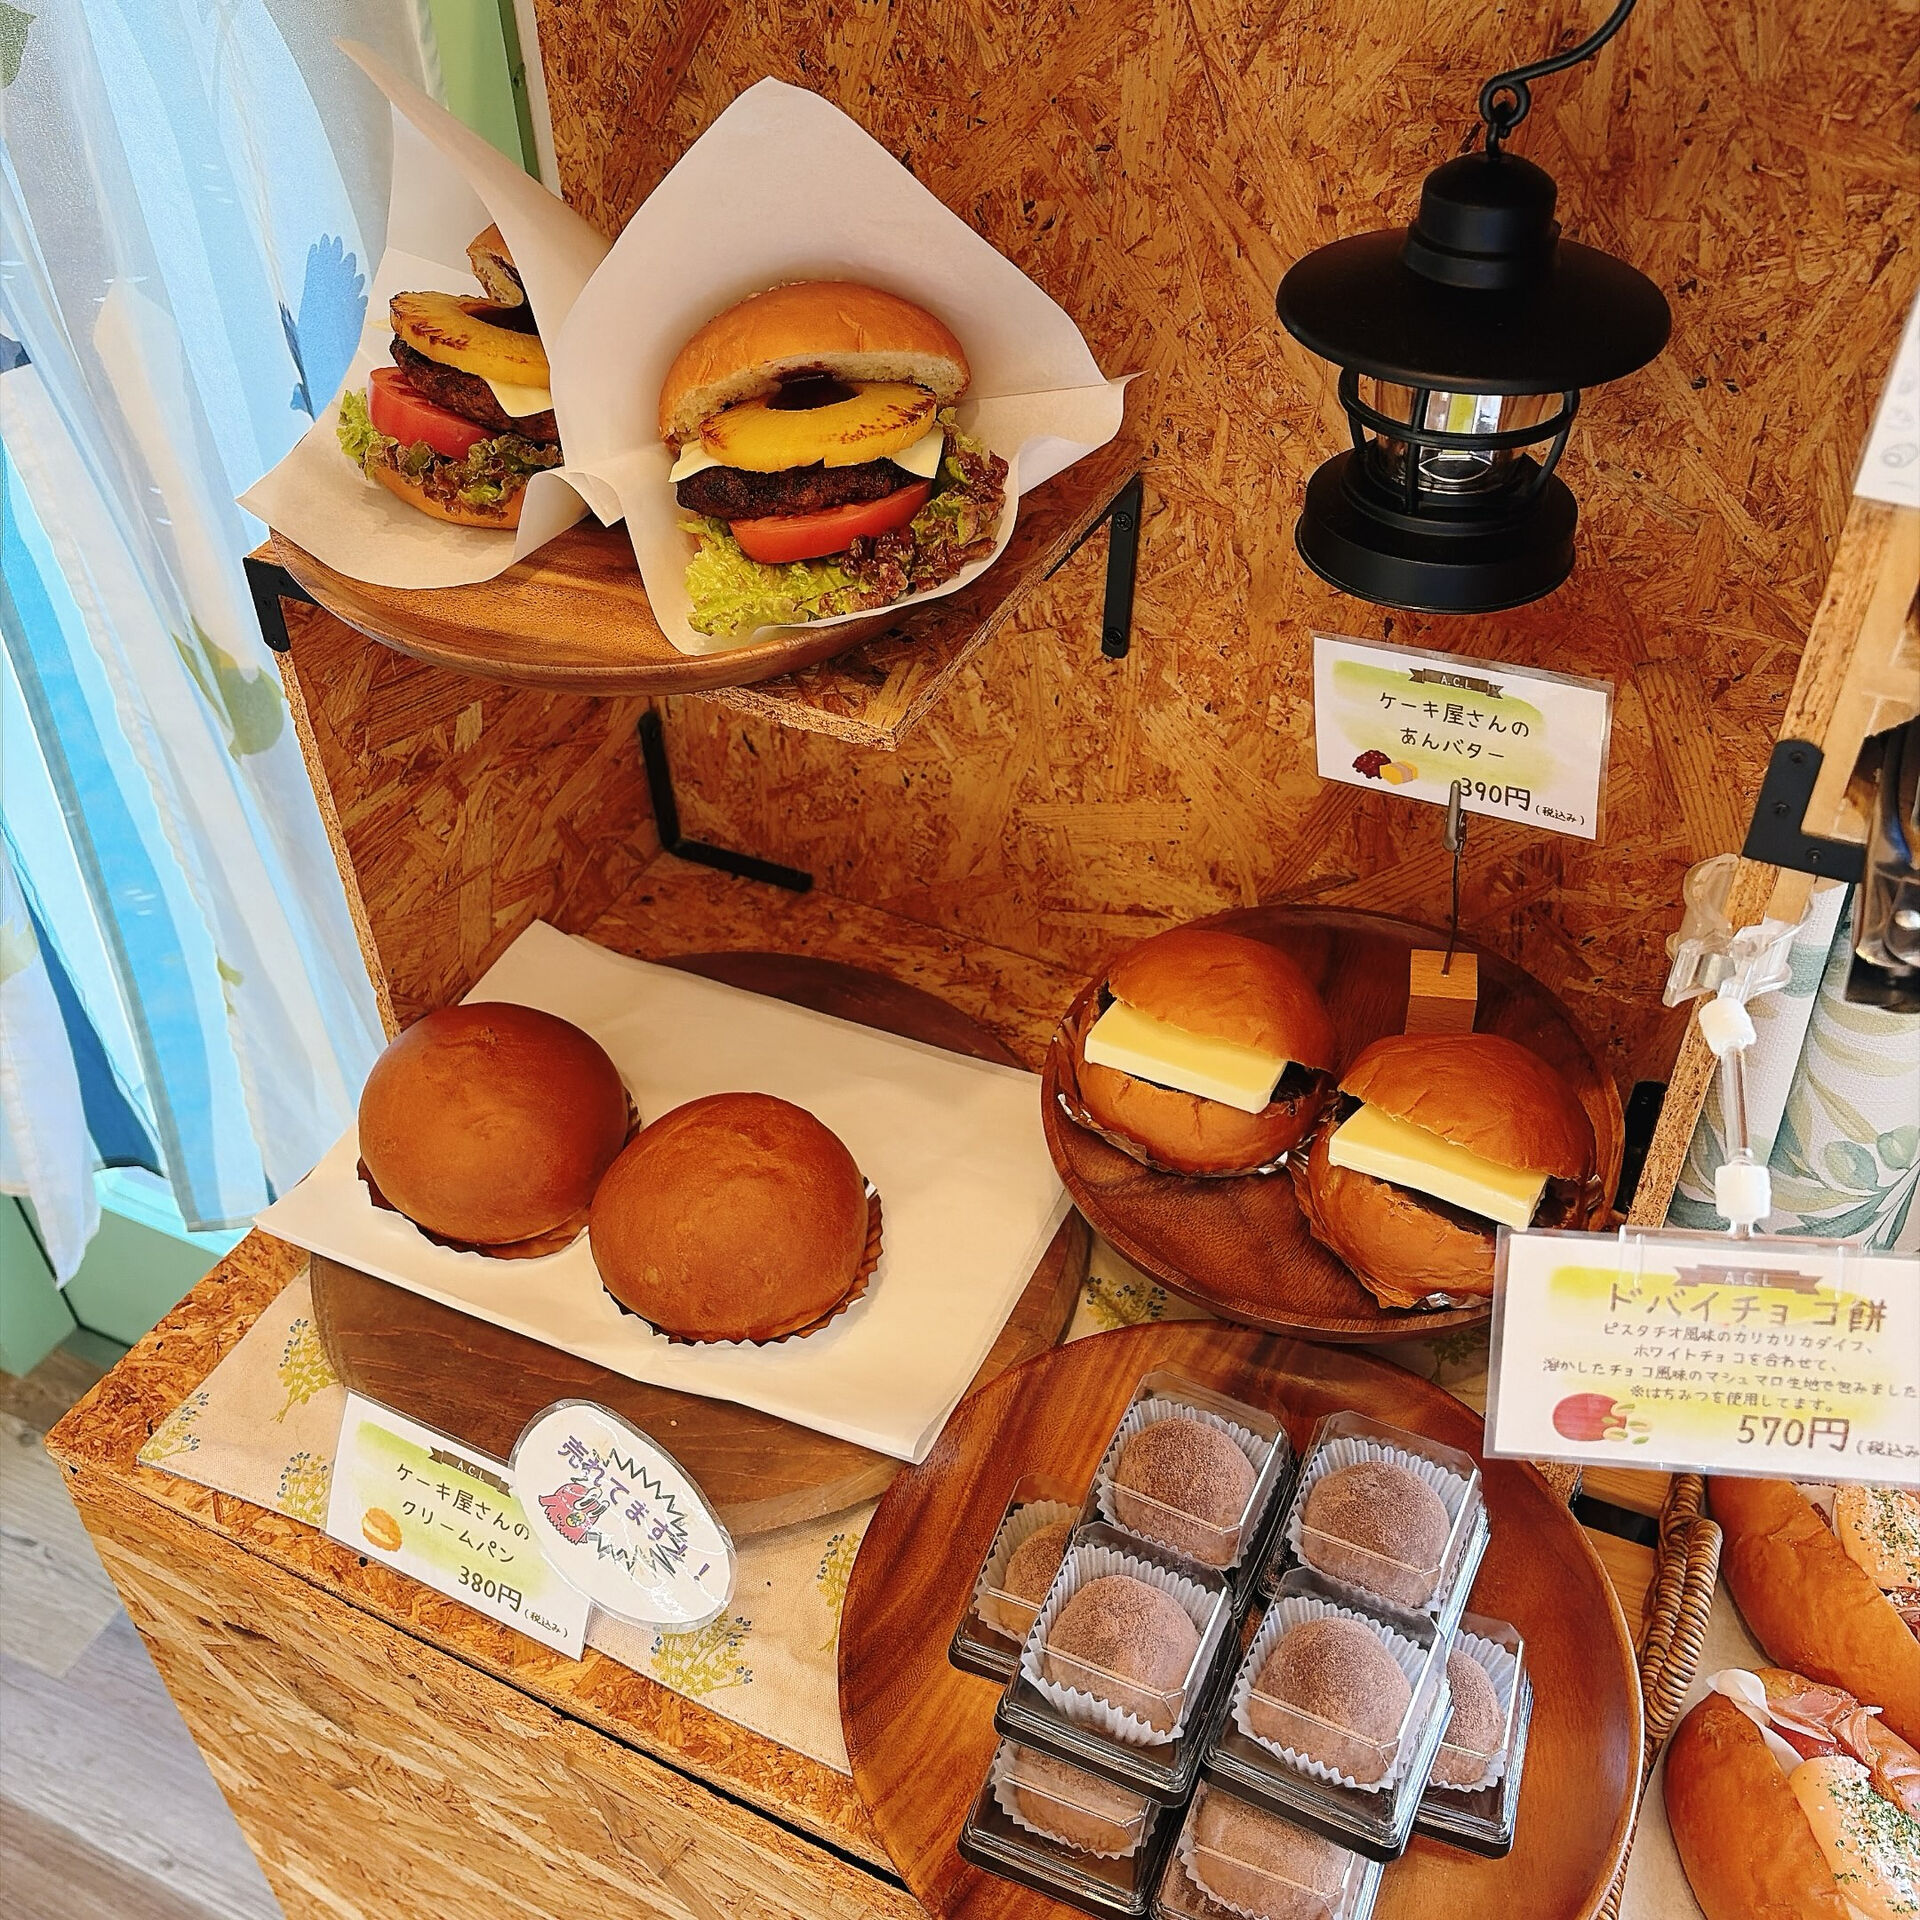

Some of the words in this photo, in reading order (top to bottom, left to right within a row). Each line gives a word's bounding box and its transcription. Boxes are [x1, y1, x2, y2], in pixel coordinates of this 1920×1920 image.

[1379, 692, 1530, 737] ケーキ屋さんの
[1400, 727, 1505, 759] あんバター
[1460, 777, 1531, 811] 390円
[1610, 1282, 1887, 1333] ドバイチョコ餅
[1737, 1414, 1850, 1452] 570円
[396, 1463, 530, 1541] ケーキ屋さんの
[402, 1500, 515, 1563] クリームパン
[458, 1565, 523, 1613] 380円
